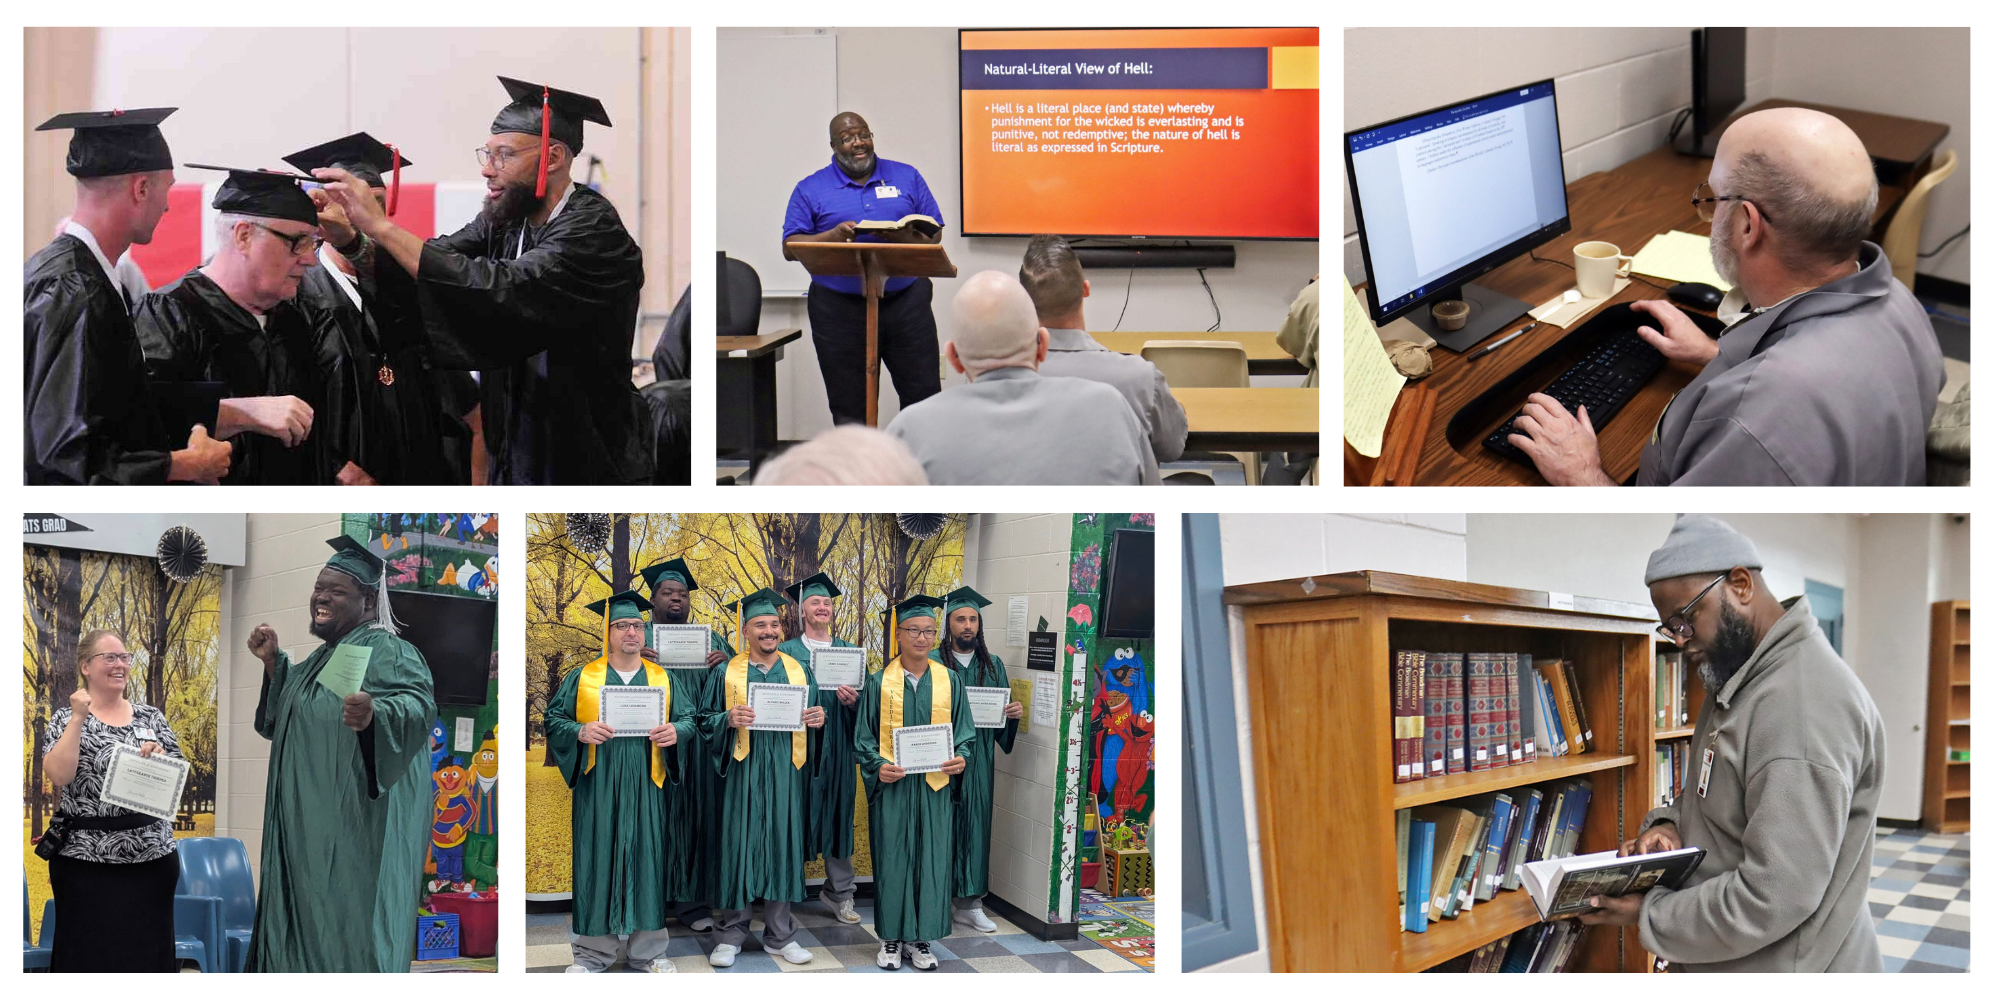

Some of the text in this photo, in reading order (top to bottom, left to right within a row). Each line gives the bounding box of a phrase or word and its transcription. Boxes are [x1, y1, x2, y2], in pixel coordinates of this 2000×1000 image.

[984, 61, 1153, 75] Natural-Literal View of Hell:
[991, 102, 1215, 116] Hell is a literal place (and state) whereby
[991, 115, 1245, 129] punishment for the wicked is everlasting and is
[991, 127, 1241, 142] punitive, not redemptive; the nature of hell is
[991, 140, 1164, 155] literal as expressed in Scripture.
[42, 518, 67, 532] GRAD
[1396, 651, 1405, 711] Bible Commentary
[1404, 653, 1412, 699] The Broadman
[1410, 669, 1418, 711] Commentary
[1477, 826, 1490, 850] Testament
[1466, 851, 1480, 880] SURVEY
